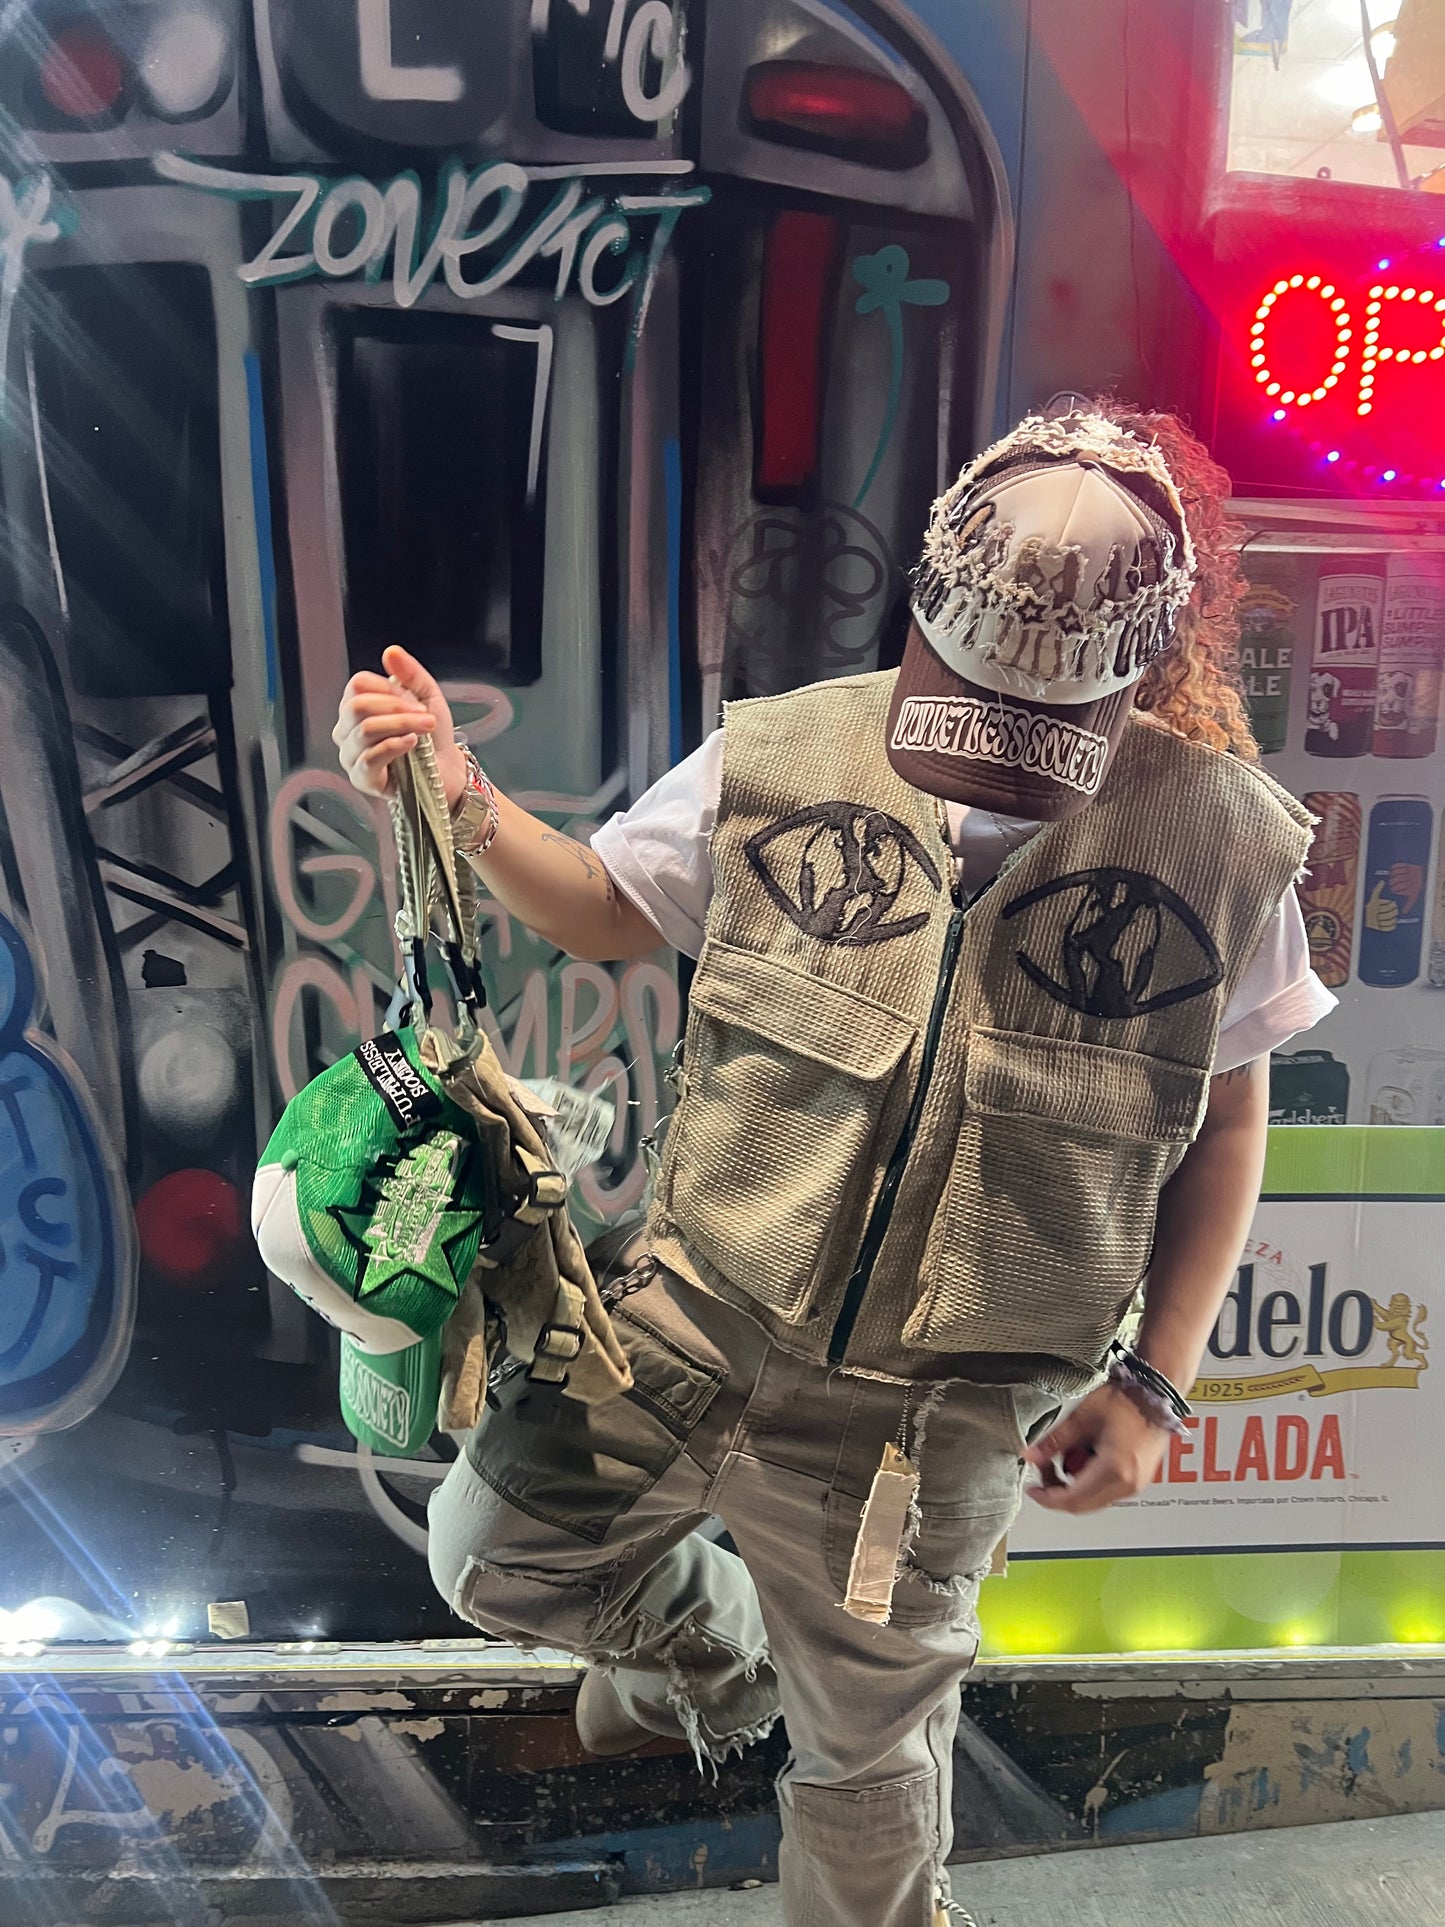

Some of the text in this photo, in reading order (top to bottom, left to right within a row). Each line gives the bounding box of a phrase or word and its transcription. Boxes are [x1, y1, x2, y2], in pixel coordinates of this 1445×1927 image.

[1319, 606, 1375, 653] IPA
[1203, 1383, 1244, 1397] 1925
[1152, 1414, 1346, 1484] ELADA
